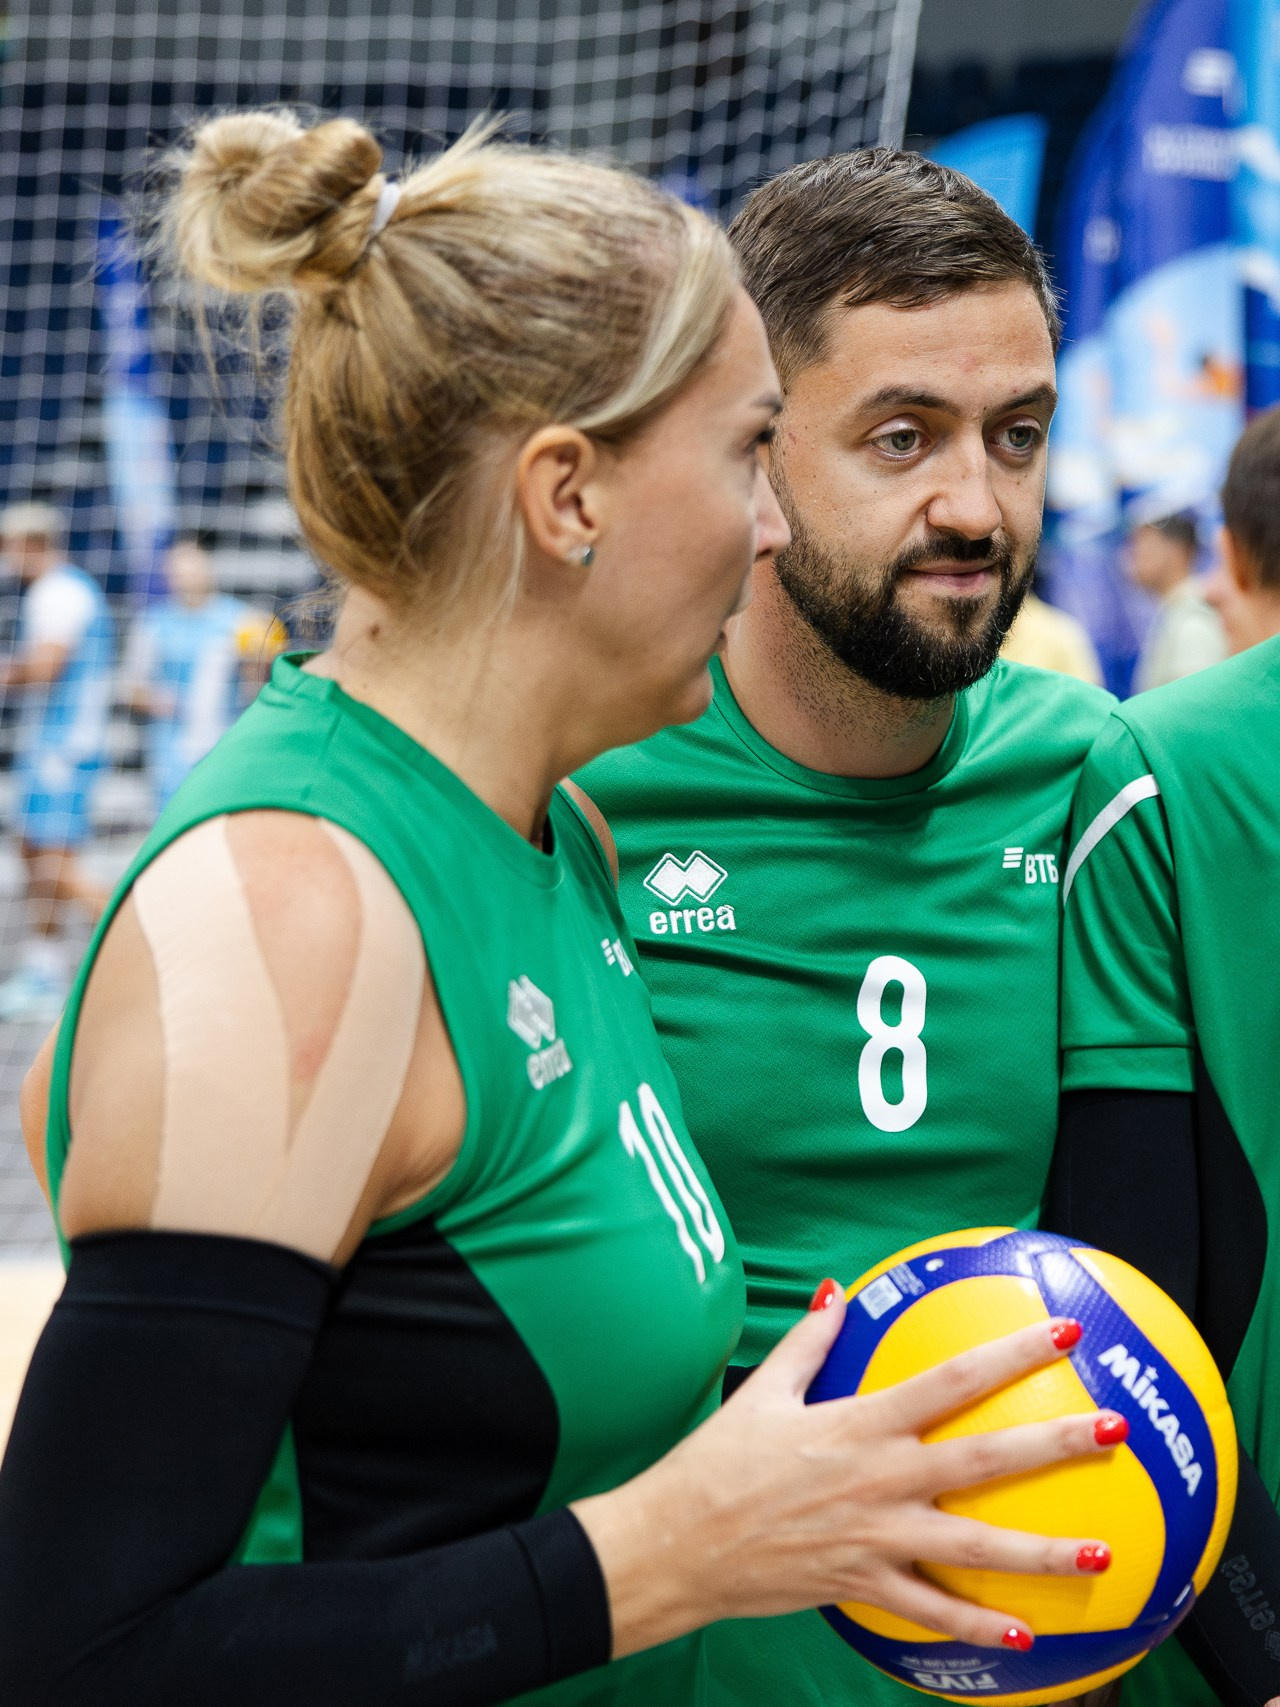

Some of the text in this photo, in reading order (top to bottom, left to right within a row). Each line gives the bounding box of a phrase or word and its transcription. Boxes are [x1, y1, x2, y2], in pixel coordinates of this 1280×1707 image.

[1025, 853, 1059, 884] ВТБ
[857, 955, 927, 1132] 8
[618, 1081, 725, 1284] 10
